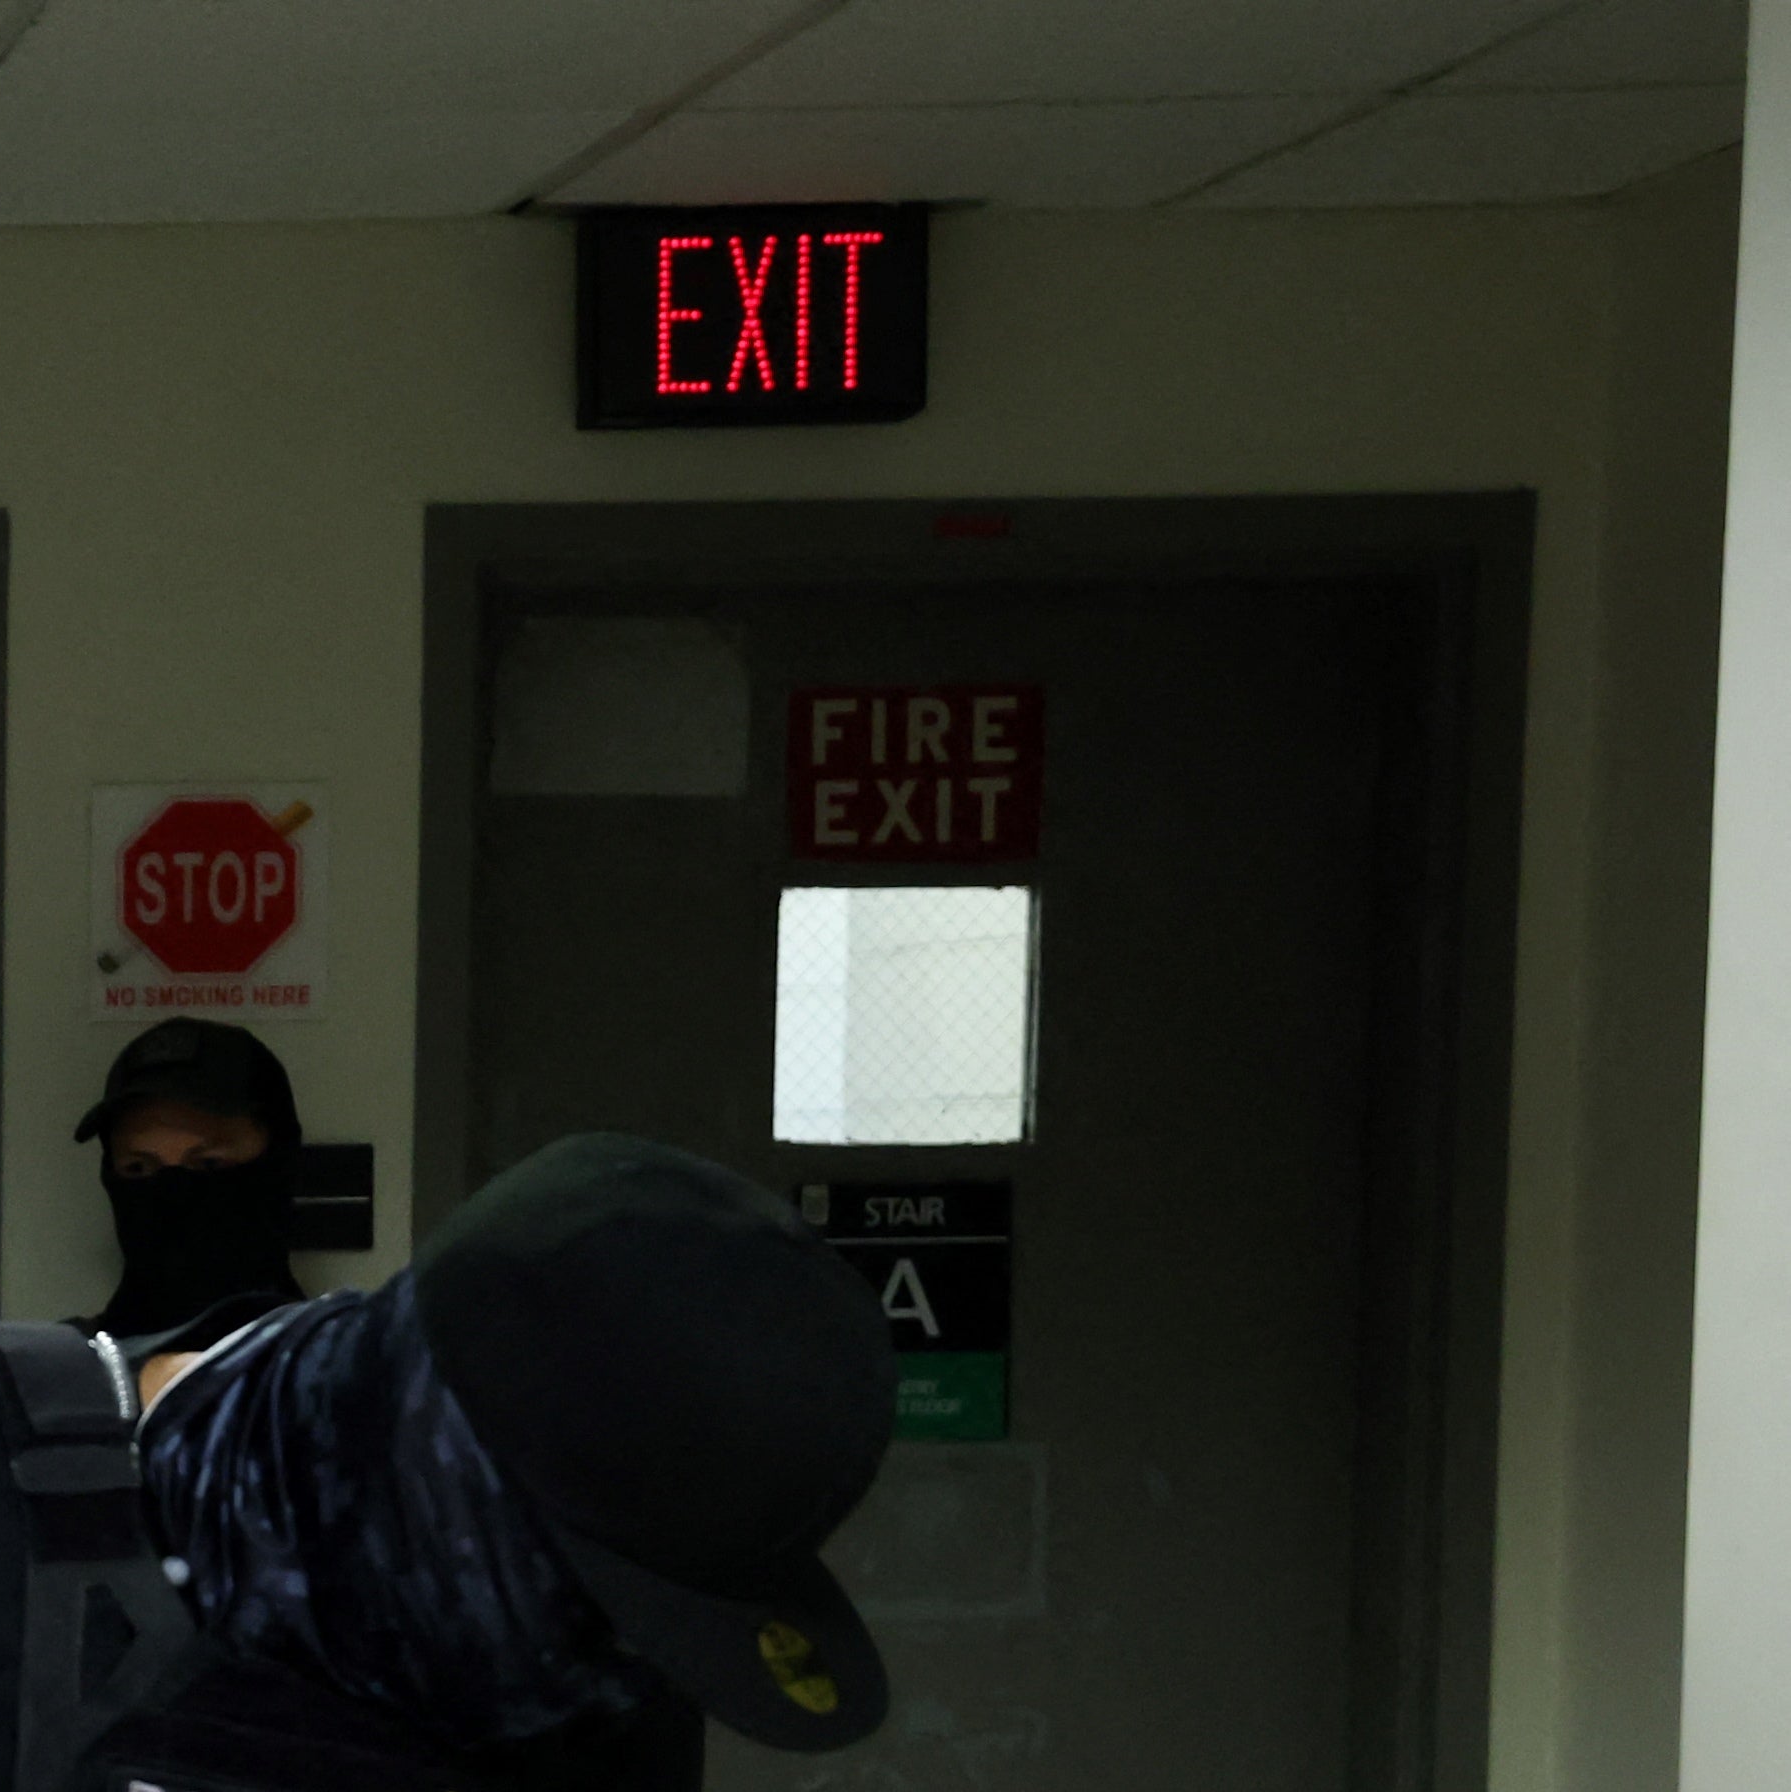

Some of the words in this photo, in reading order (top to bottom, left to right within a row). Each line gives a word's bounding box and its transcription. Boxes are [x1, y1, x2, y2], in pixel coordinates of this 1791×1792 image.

[656, 231, 884, 394] EXIT
[811, 695, 1018, 766] FIRE
[815, 775, 1014, 847] EXIT
[134, 850, 287, 926] STOP
[106, 986, 136, 1006] NO
[144, 985, 245, 1006] SMOKING
[253, 984, 311, 1006] HERE
[864, 1196, 946, 1229] STAIR
[880, 1257, 943, 1339] A
